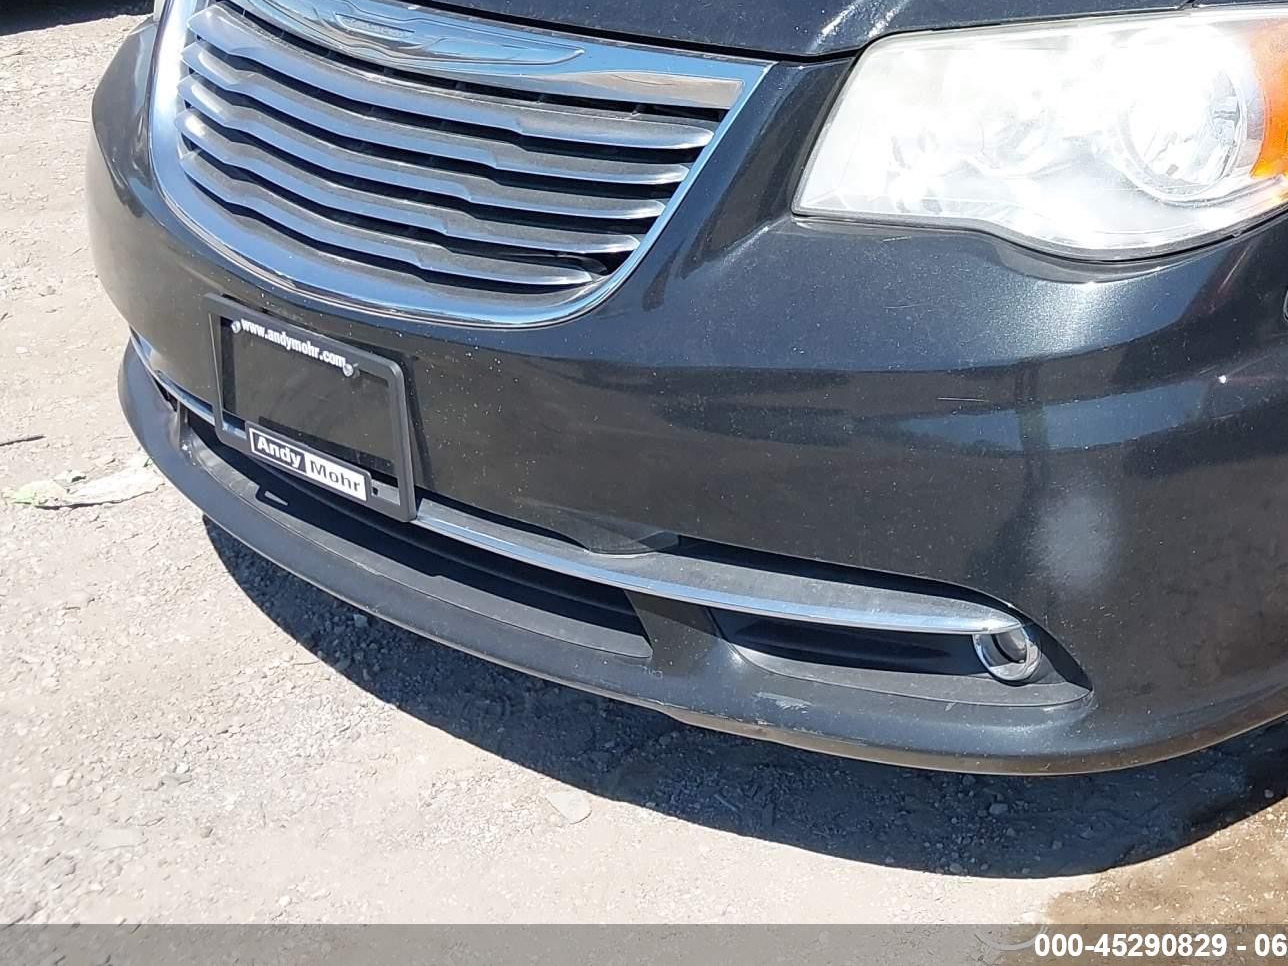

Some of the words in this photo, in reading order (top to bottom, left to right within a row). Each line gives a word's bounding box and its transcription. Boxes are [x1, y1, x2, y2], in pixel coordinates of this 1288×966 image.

[241, 318, 346, 368] www.andymohr.com
[257, 435, 302, 468] Andy
[310, 460, 361, 493] Mohr
